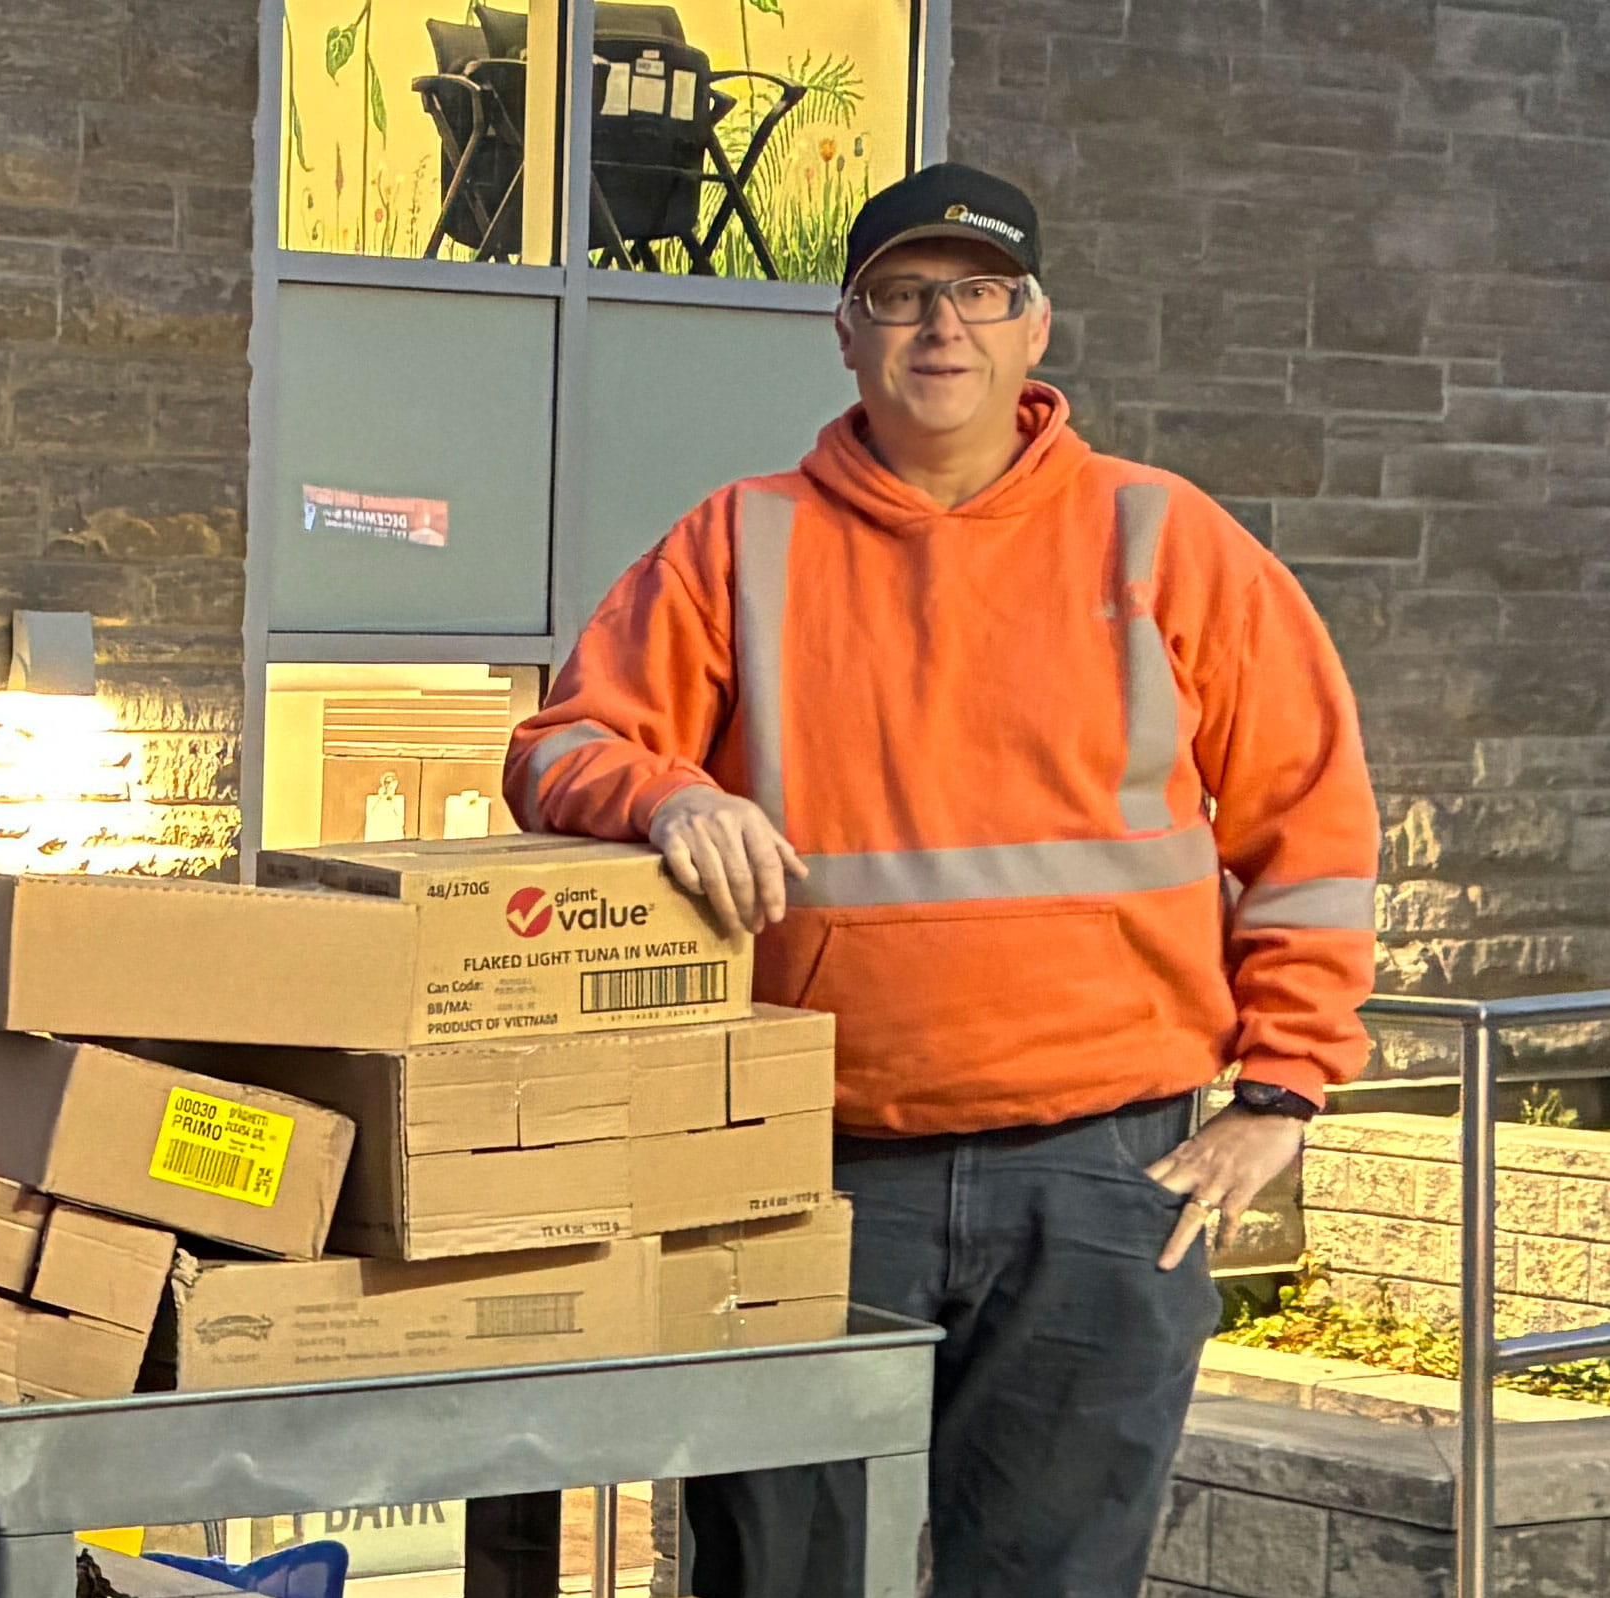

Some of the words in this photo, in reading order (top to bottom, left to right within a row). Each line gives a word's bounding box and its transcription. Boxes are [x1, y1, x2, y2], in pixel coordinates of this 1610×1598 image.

[427, 881, 490, 900] 48/170G
[554, 887, 598, 908] giant
[557, 898, 649, 932] value
[463, 954, 522, 972] FLAKED
[527, 950, 571, 966] LIGHT
[575, 947, 620, 964] TUNA
[624, 946, 641, 960] IN
[645, 941, 698, 958] WATER
[427, 982, 450, 995] Can
[427, 1018, 482, 1035] PRODUCT
[486, 1018, 500, 1031] OF
[504, 1014, 558, 1029] VIETNAM
[175, 1096, 217, 1120] 00030
[171, 1114, 223, 1141] PRIMO
